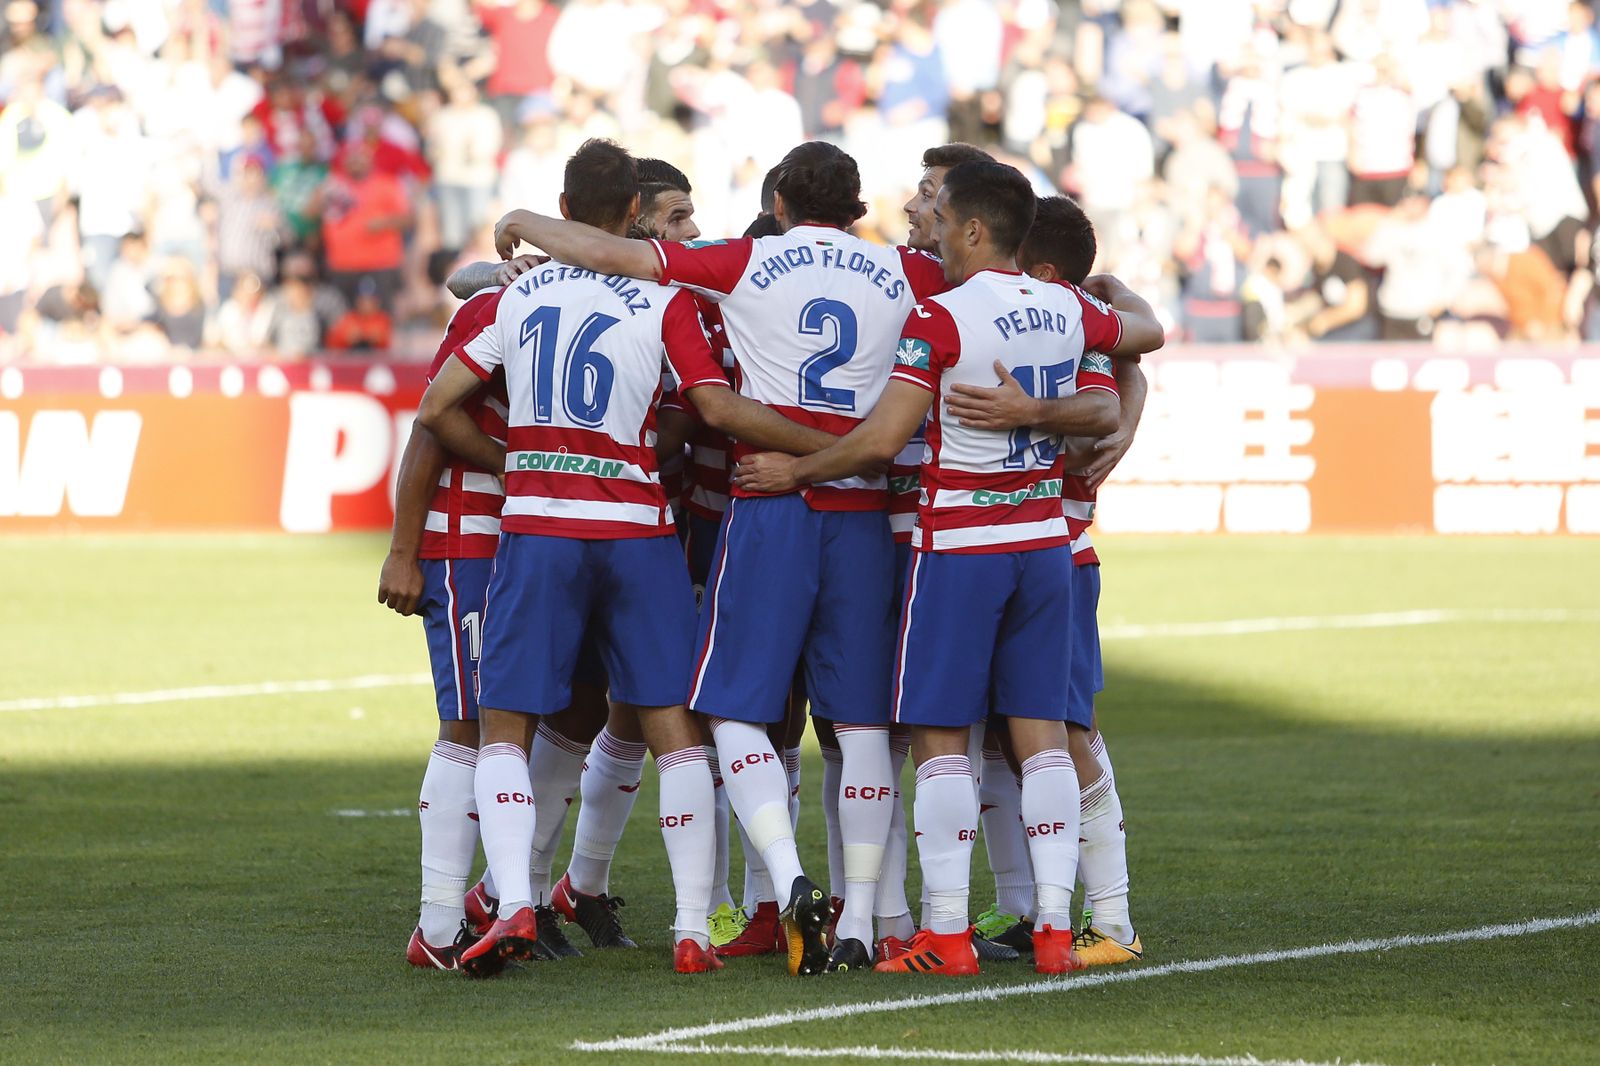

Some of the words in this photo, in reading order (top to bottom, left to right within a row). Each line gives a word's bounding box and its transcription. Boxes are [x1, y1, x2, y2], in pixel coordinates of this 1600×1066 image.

[750, 246, 814, 290] CHICO
[822, 248, 905, 300] FLORES
[602, 275, 652, 316] DIAZ
[993, 307, 1066, 341] PEDRO
[520, 305, 621, 428] 16
[798, 297, 858, 411] 2
[731, 753, 774, 774] GCF
[845, 786, 891, 801] GCF
[1027, 822, 1066, 838] GCF
